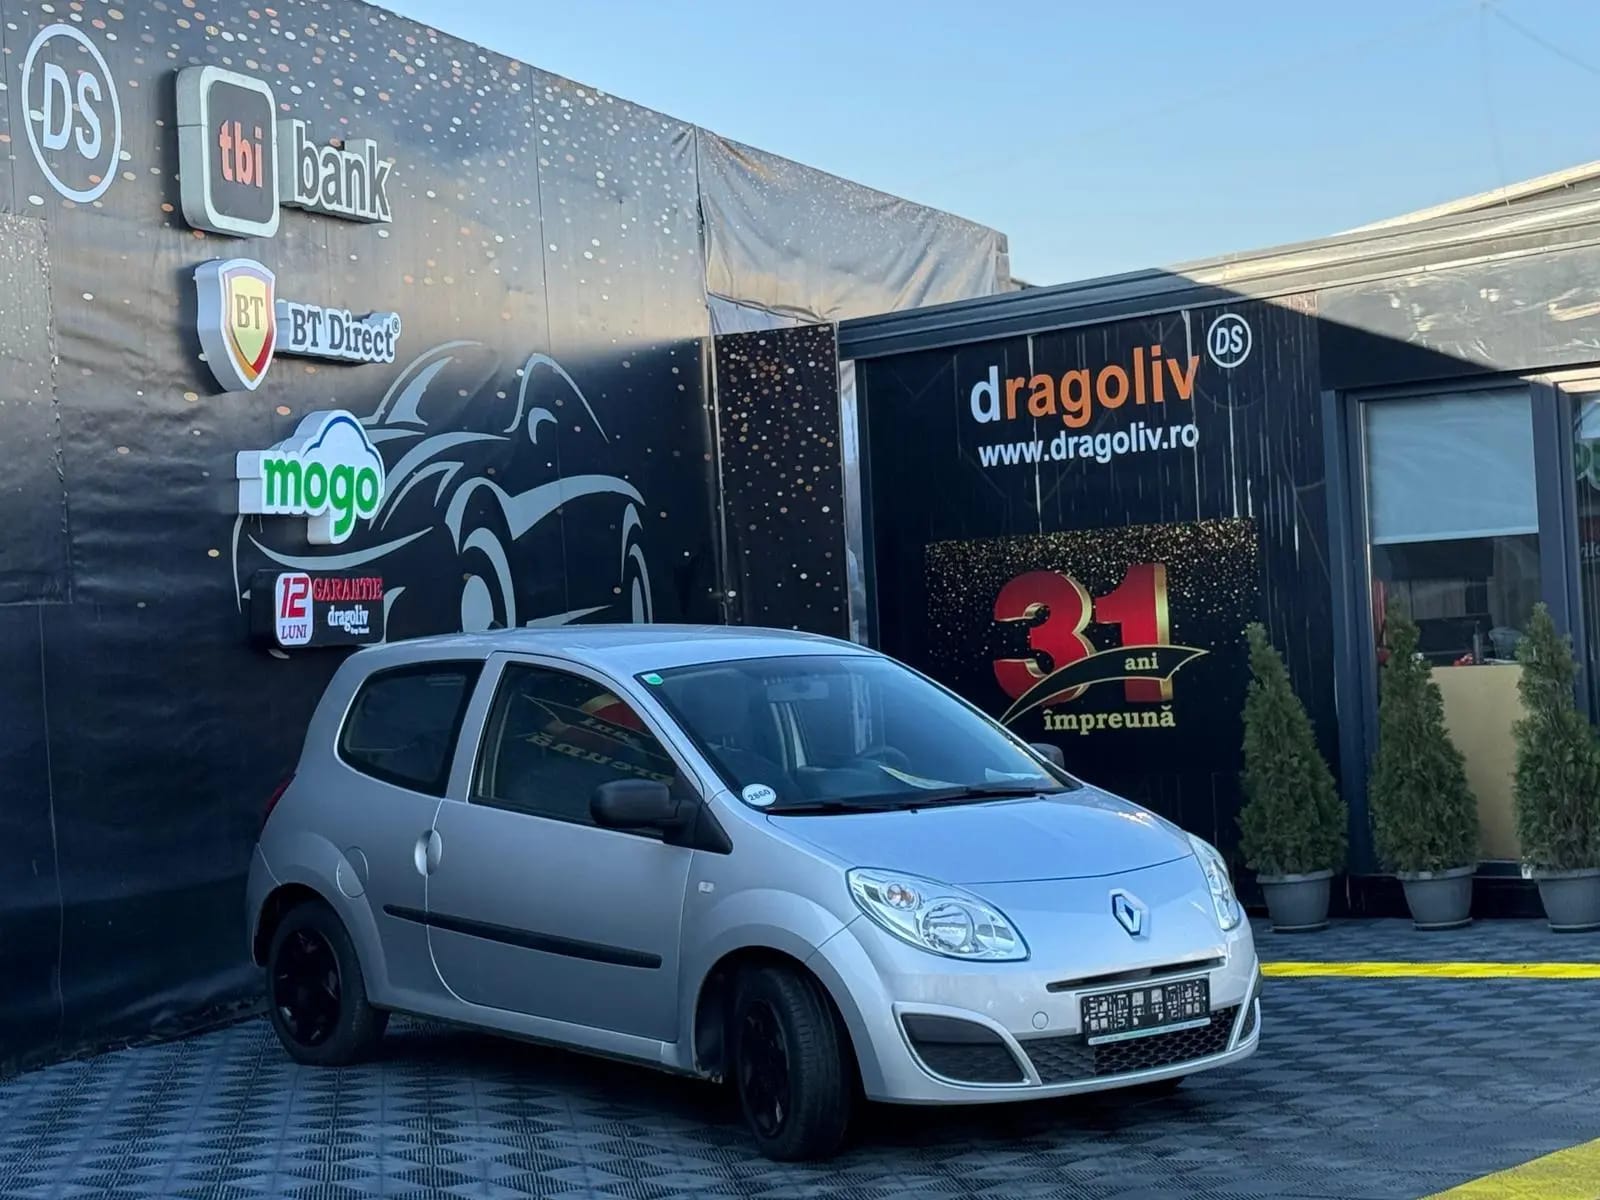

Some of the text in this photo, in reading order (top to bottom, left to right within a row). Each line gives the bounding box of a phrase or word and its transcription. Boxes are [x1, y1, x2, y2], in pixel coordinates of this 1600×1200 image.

[43, 62, 101, 160] DS
[219, 119, 392, 222] tbi bank
[235, 294, 264, 330] BT
[291, 309, 321, 347] BT
[1216, 325, 1243, 355] DS
[970, 344, 1199, 428] dragoliv
[978, 421, 1199, 467] www.dragoliv.ro
[264, 458, 379, 537] mogo
[280, 577, 309, 619] 12
[313, 577, 383, 601] GARANTIE
[281, 624, 307, 640] LUNI
[327, 604, 369, 633] dragoliv
[993, 562, 1173, 705] 31
[1124, 652, 1159, 671] ani
[1043, 705, 1175, 735] împreună
